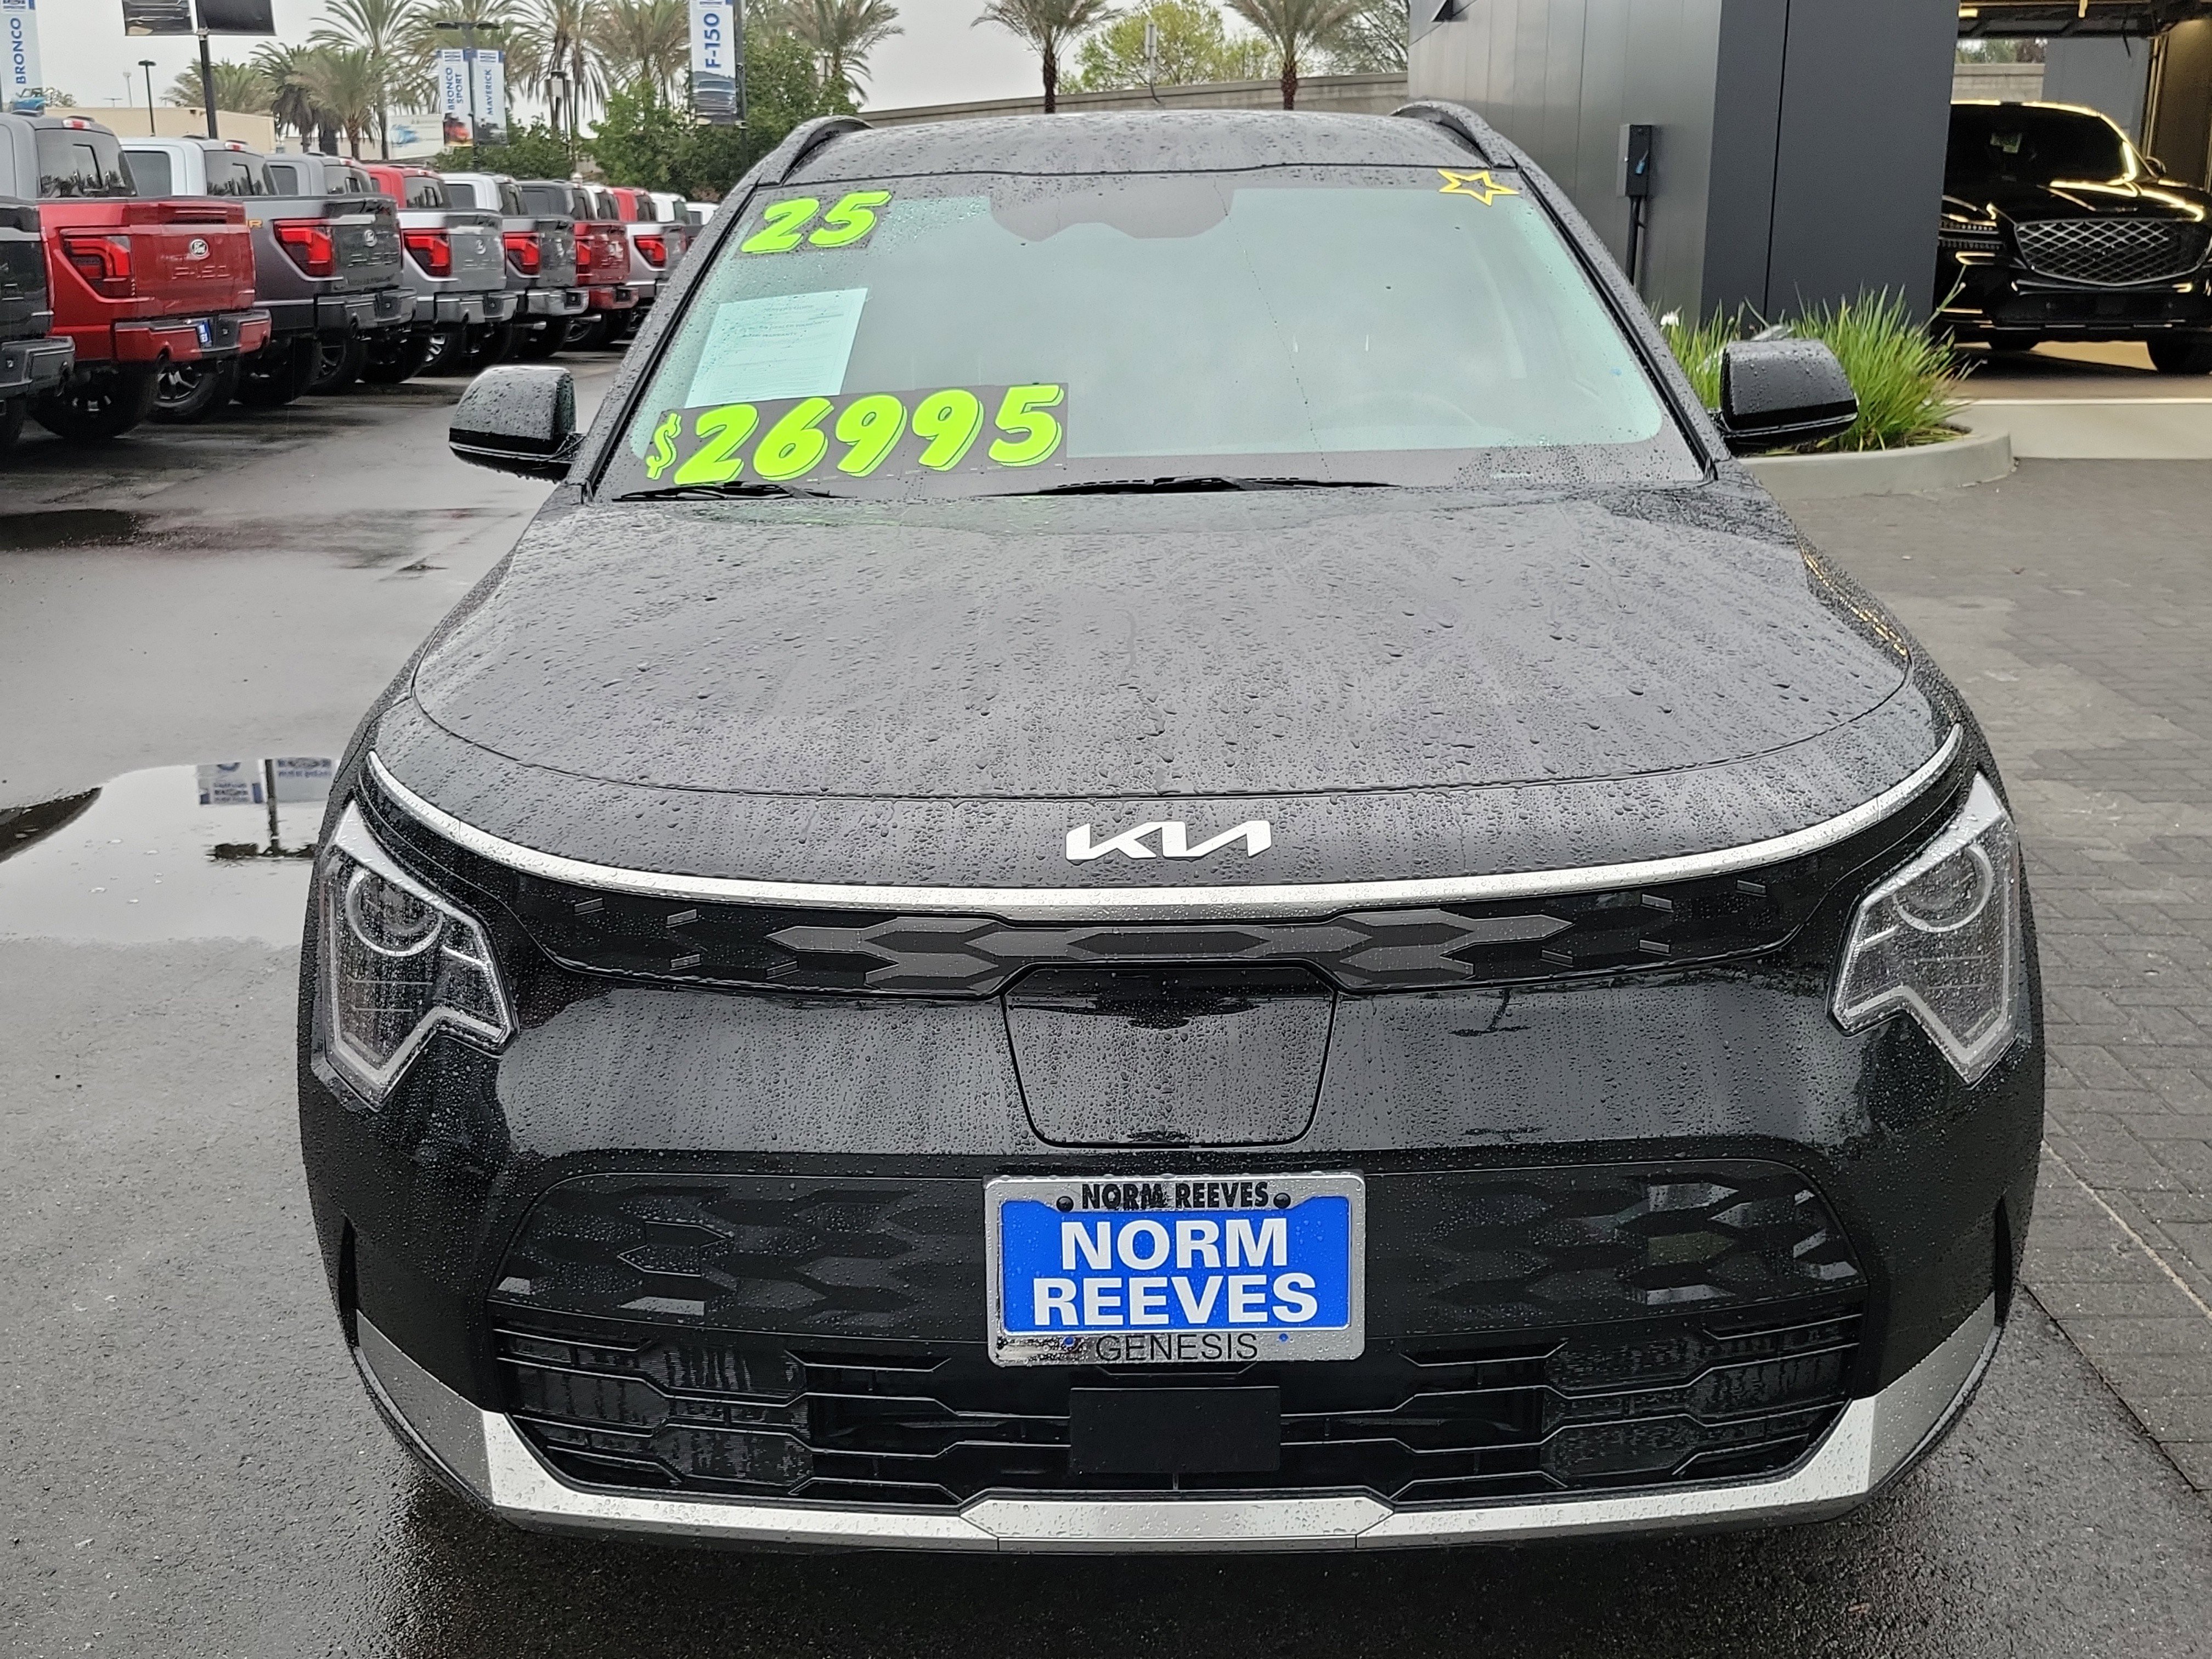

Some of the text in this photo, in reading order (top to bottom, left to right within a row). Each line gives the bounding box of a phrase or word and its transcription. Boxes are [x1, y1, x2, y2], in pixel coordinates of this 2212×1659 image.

[10, 18, 26, 84] BRONCO
[703, 13, 721, 68] F-150
[445, 67, 455, 110] BRONCO
[455, 74, 464, 104] SPORT
[484, 69, 493, 115] MAVERICK
[741, 191, 893, 254] 25
[646, 384, 1064, 485] $26995
[1065, 820, 1272, 860] KIA
[1082, 1182, 1269, 1210] NORM REEVES
[1061, 1218, 1288, 1270] NORM
[1033, 1272, 1318, 1326] REEVES
[1096, 1333, 1258, 1361] GENESIS
